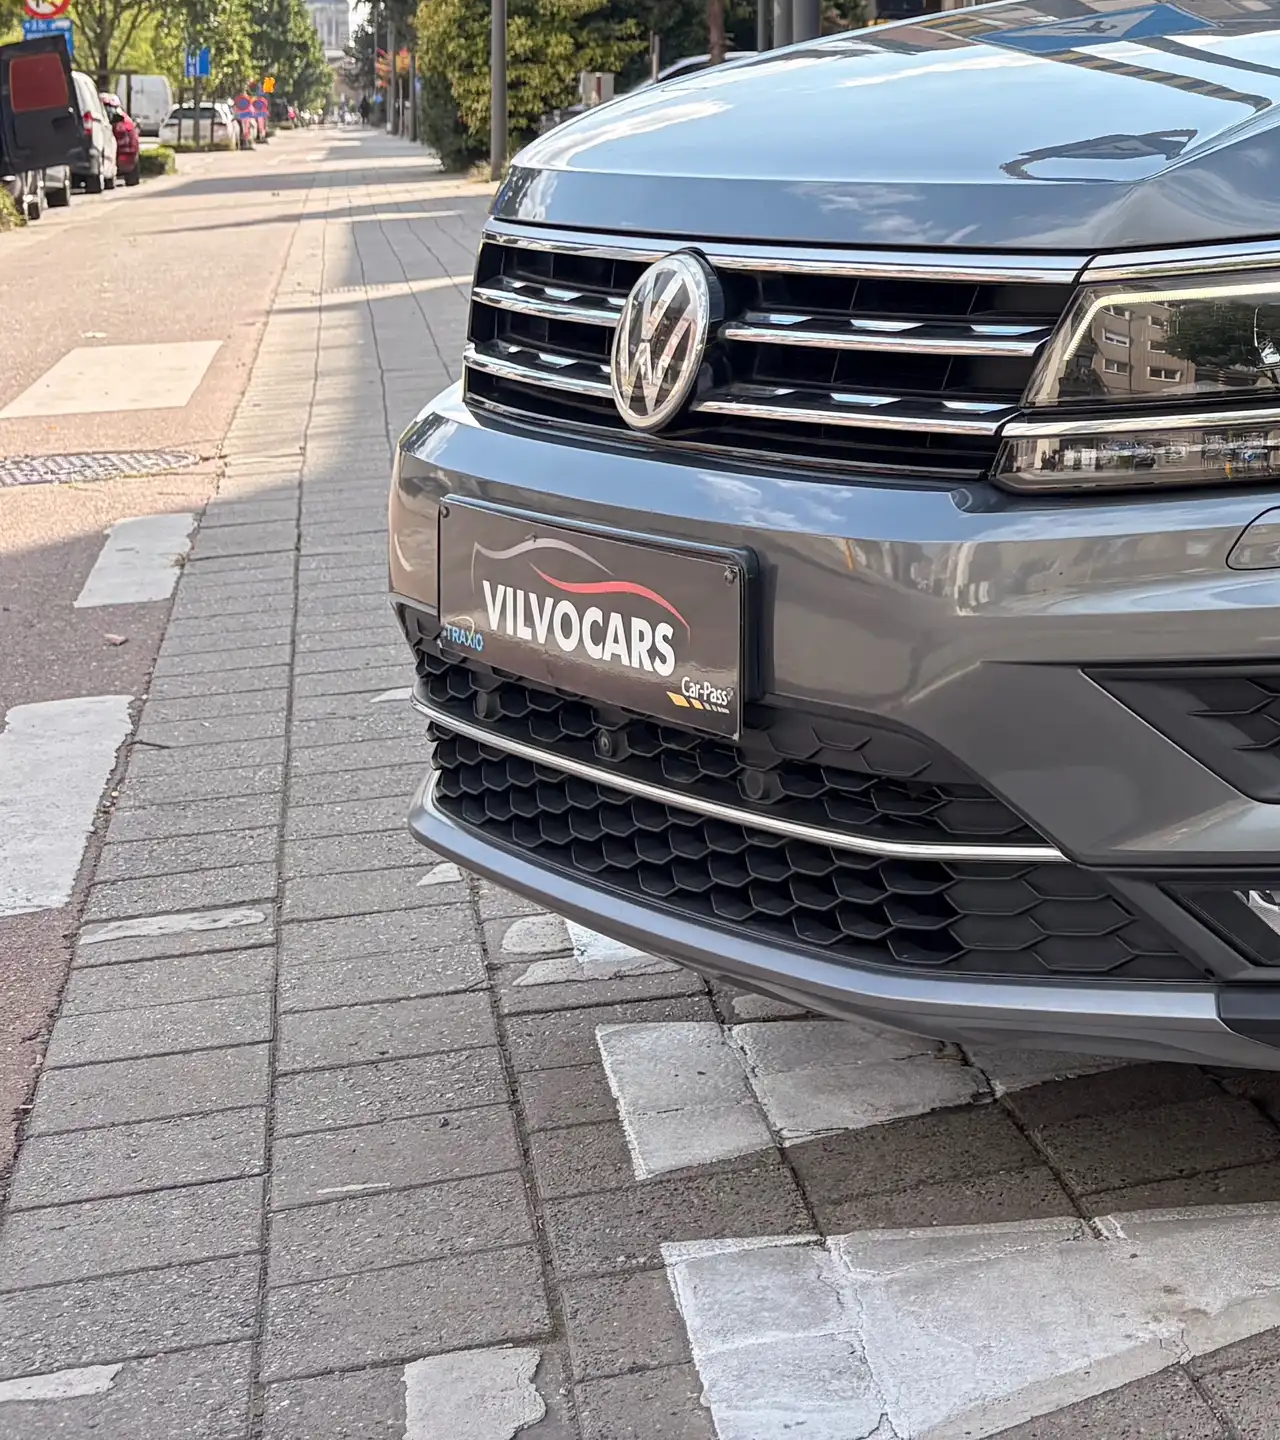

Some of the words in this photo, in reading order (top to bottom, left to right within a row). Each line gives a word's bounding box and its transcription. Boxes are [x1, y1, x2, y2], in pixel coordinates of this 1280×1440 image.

[444, 622, 483, 651] TRAXIO
[482, 580, 676, 677] VILVOCARS
[681, 676, 728, 706] Car-Pass
